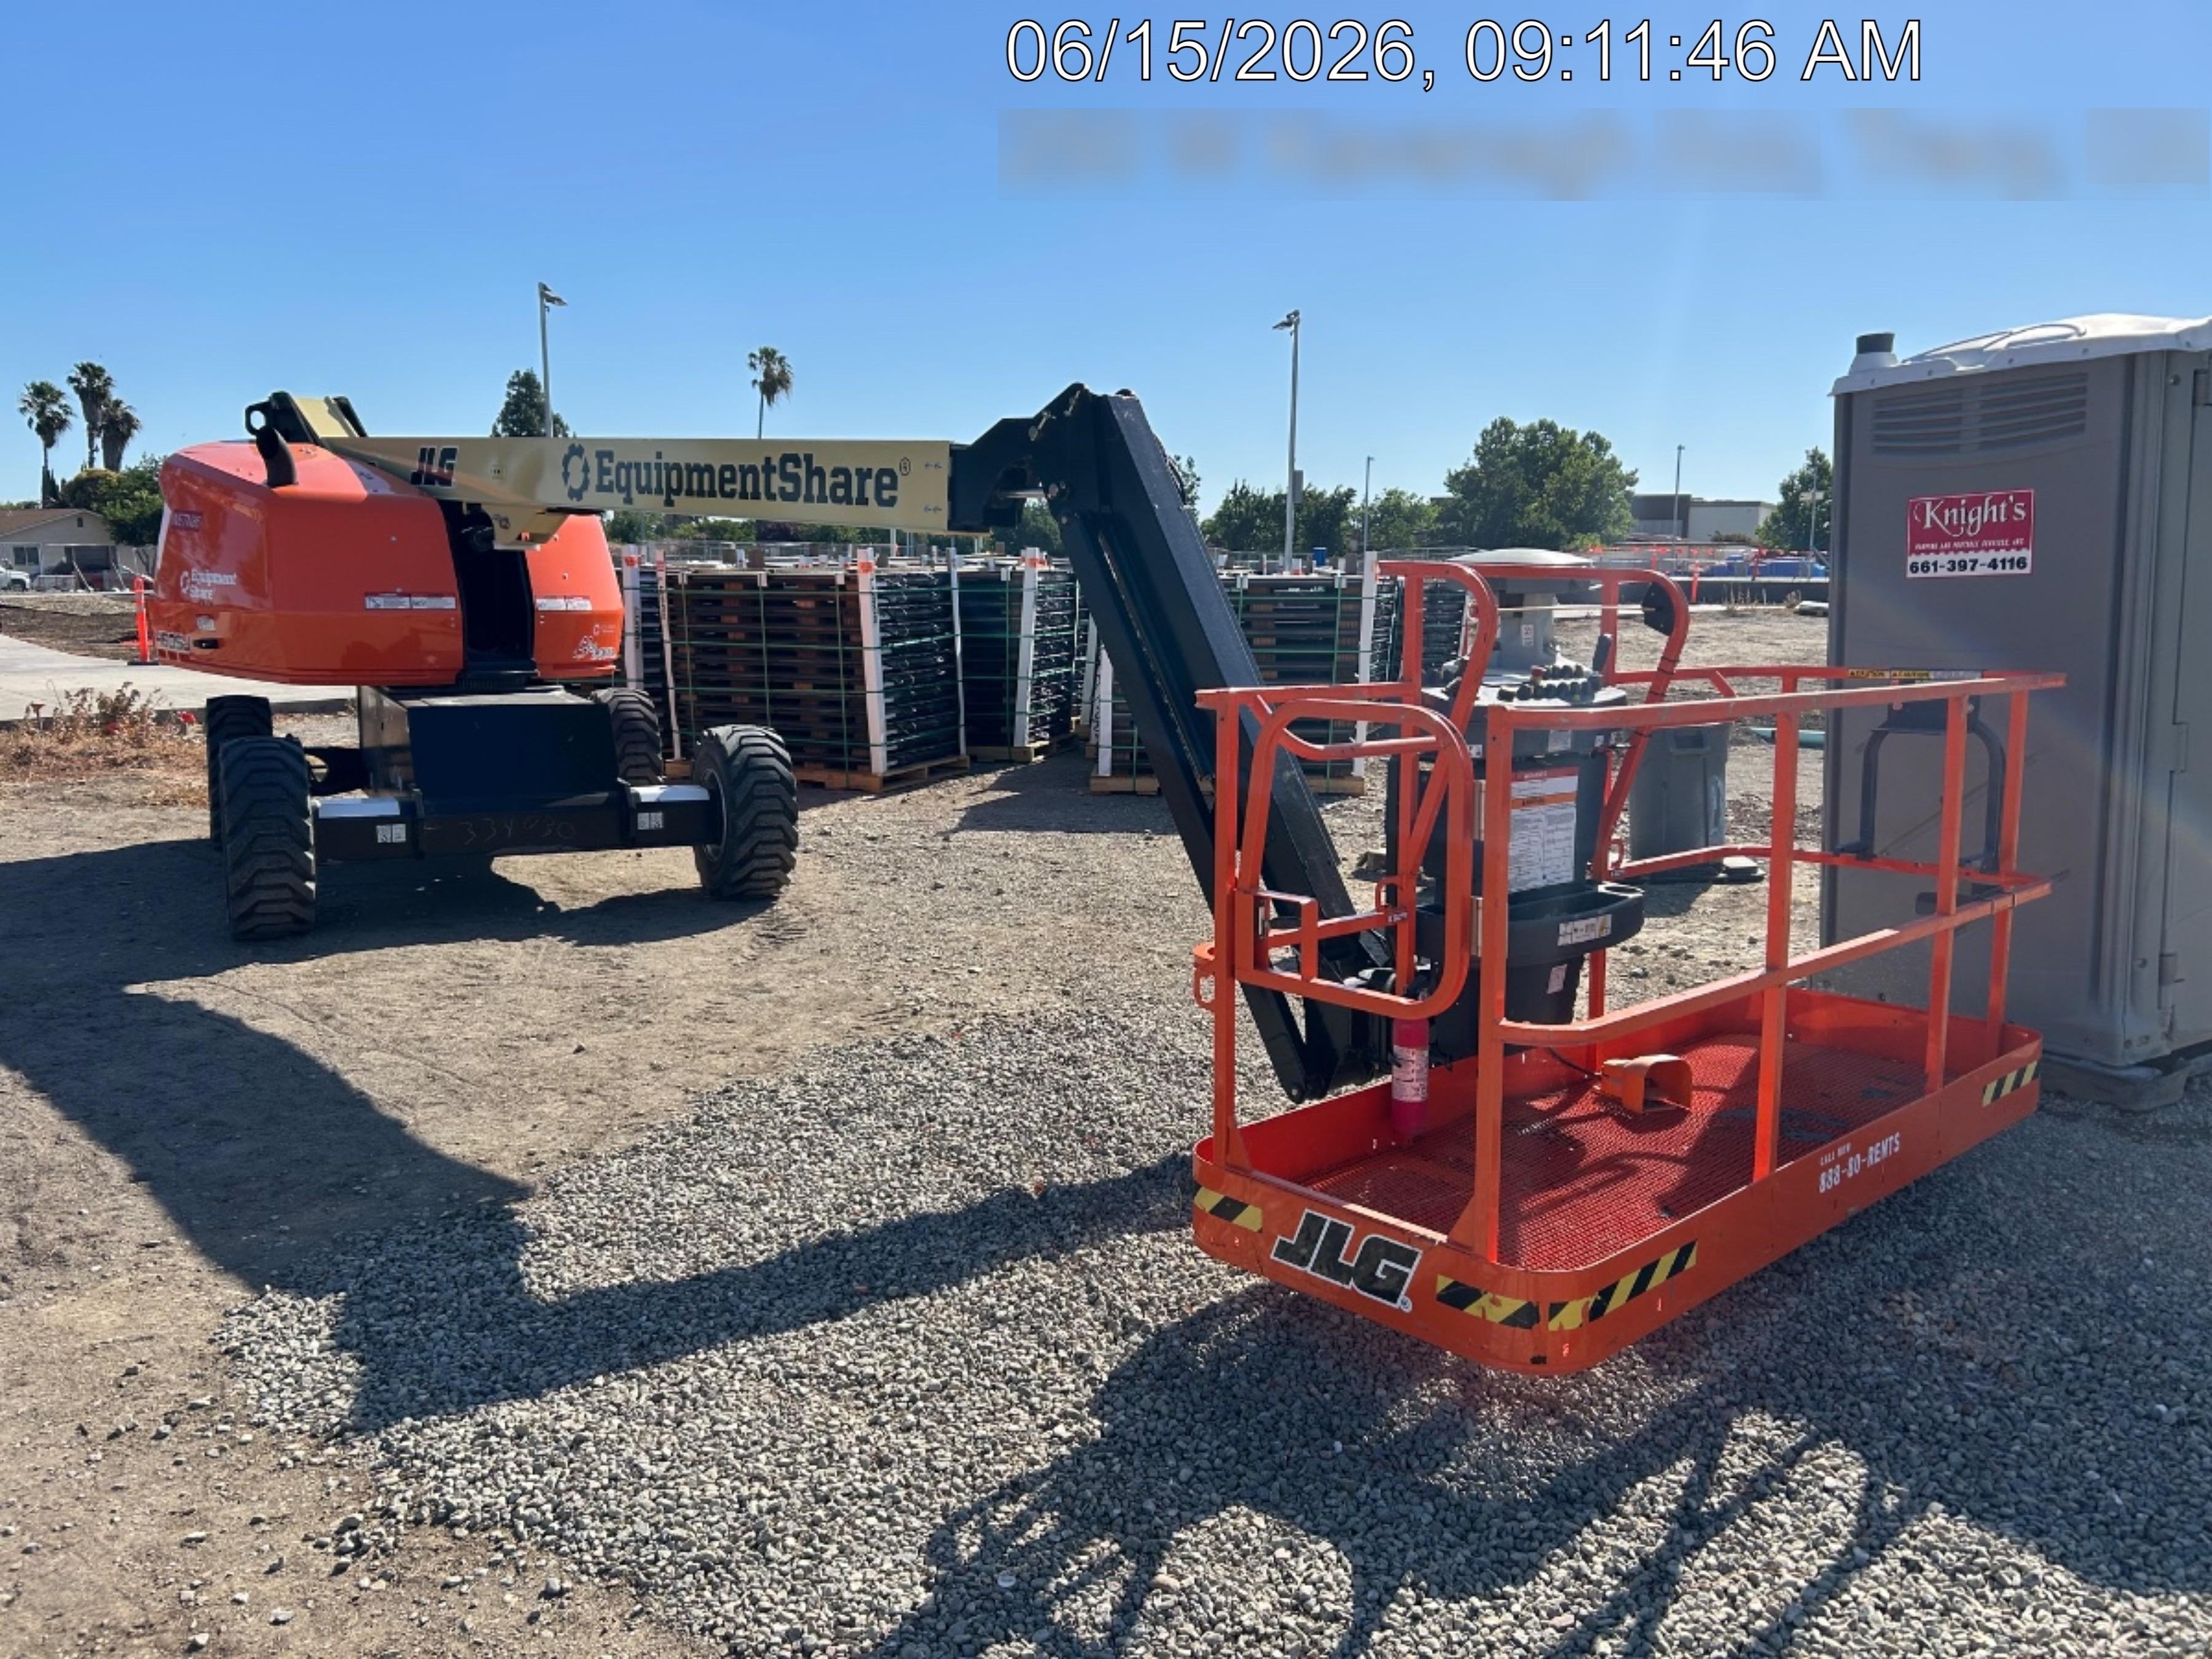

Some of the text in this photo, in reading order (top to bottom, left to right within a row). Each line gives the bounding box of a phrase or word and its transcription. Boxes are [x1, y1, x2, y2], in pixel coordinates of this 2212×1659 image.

[410, 445, 458, 488] JLG
[595, 450, 899, 508] EquipmentShare
[1913, 494, 2026, 537] Knight's
[1909, 556, 2028, 574] 661-397-4116
[1270, 1208, 1423, 1309] JLG
